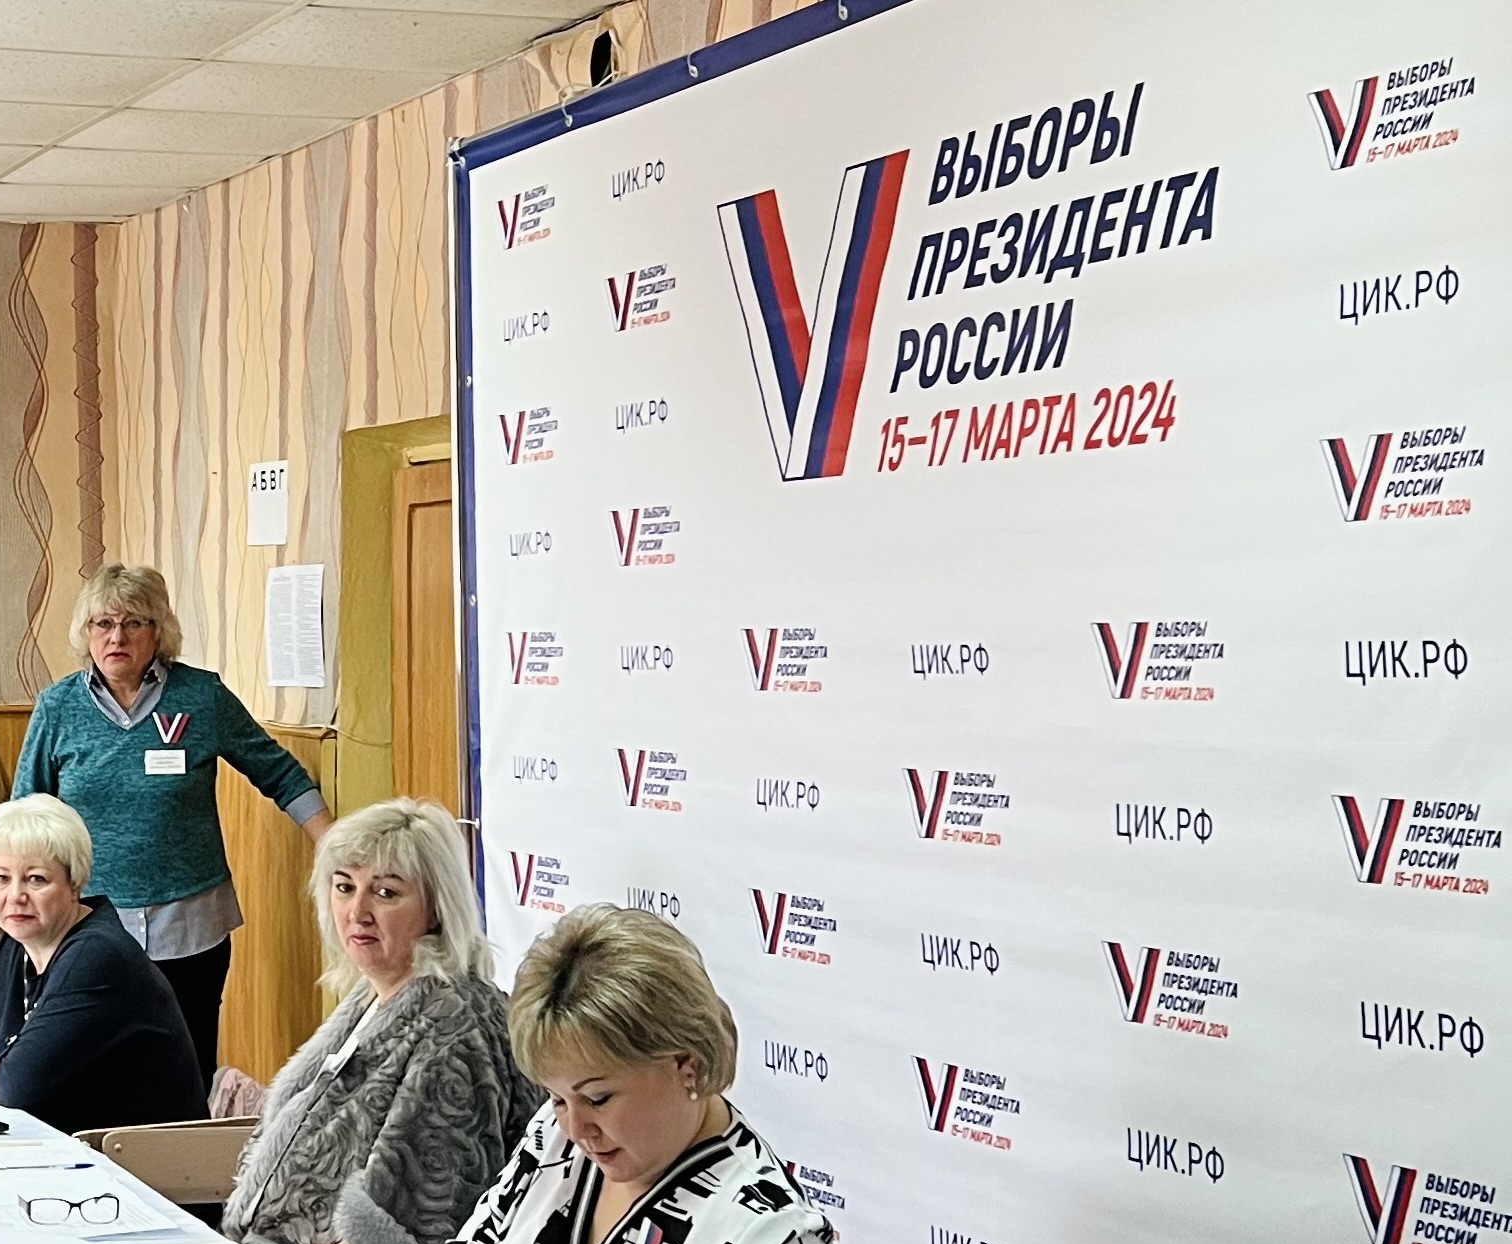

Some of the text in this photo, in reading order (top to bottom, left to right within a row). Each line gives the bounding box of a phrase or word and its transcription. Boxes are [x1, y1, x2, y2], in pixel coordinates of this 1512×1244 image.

[1387, 57, 1453, 90] ВЫБОРЫ
[1381, 77, 1475, 116] ПРЕЗИДЕНТА
[1372, 111, 1434, 141] РОССИИ
[928, 82, 1145, 206] ВЫБОРЫ
[612, 159, 665, 201] ЦИК.РФ
[907, 166, 1220, 300] ПРЕЗИДЕНТА
[1340, 265, 1459, 326] ЦИК.РФ
[890, 298, 1074, 394] РОССИИ
[616, 398, 668, 434] ЦИК.РФ
[877, 379, 1176, 473] 15–17 МАРТА 2024
[1400, 426, 1466, 449] ВЫБОРЫ
[1393, 449, 1484, 474] ПРЕЗИДЕНТА
[1384, 477, 1444, 498] РОССИИ
[1155, 621, 1208, 637] ВЫБОРЫ
[621, 646, 673, 675] ЦИК.РФ
[912, 643, 989, 680] ЦИК.РФ
[1150, 643, 1224, 661] ПРЕЗИДЕНТА
[1345, 638, 1468, 686] ЦИК.РФ
[1145, 666, 1192, 681] РОССИИ
[757, 778, 820, 812] ЦИК.РФ
[1413, 801, 1480, 821] ВЫБОРЫ
[1116, 803, 1212, 845] ЦИК.РФ
[1406, 825, 1502, 848] ПРЕЗИДЕНТА
[1398, 849, 1460, 870] РОССИИ
[921, 933, 999, 976] ЦИК.РФ
[1167, 951, 1220, 973] ВЫБОРЫ
[1162, 972, 1238, 998] ПРЕЗИДЕНТА
[1157, 993, 1205, 1015] РОССИИ
[1361, 1001, 1484, 1058] ЦИК.РФ
[765, 1040, 828, 1082] ЦИК.РФ
[1127, 1128, 1224, 1184] ЦИК.РФ
[1425, 1174, 1496, 1204] ВЫБОРЫ
[1420, 1197, 1512, 1233] ПРЕЗИДЕНТ
